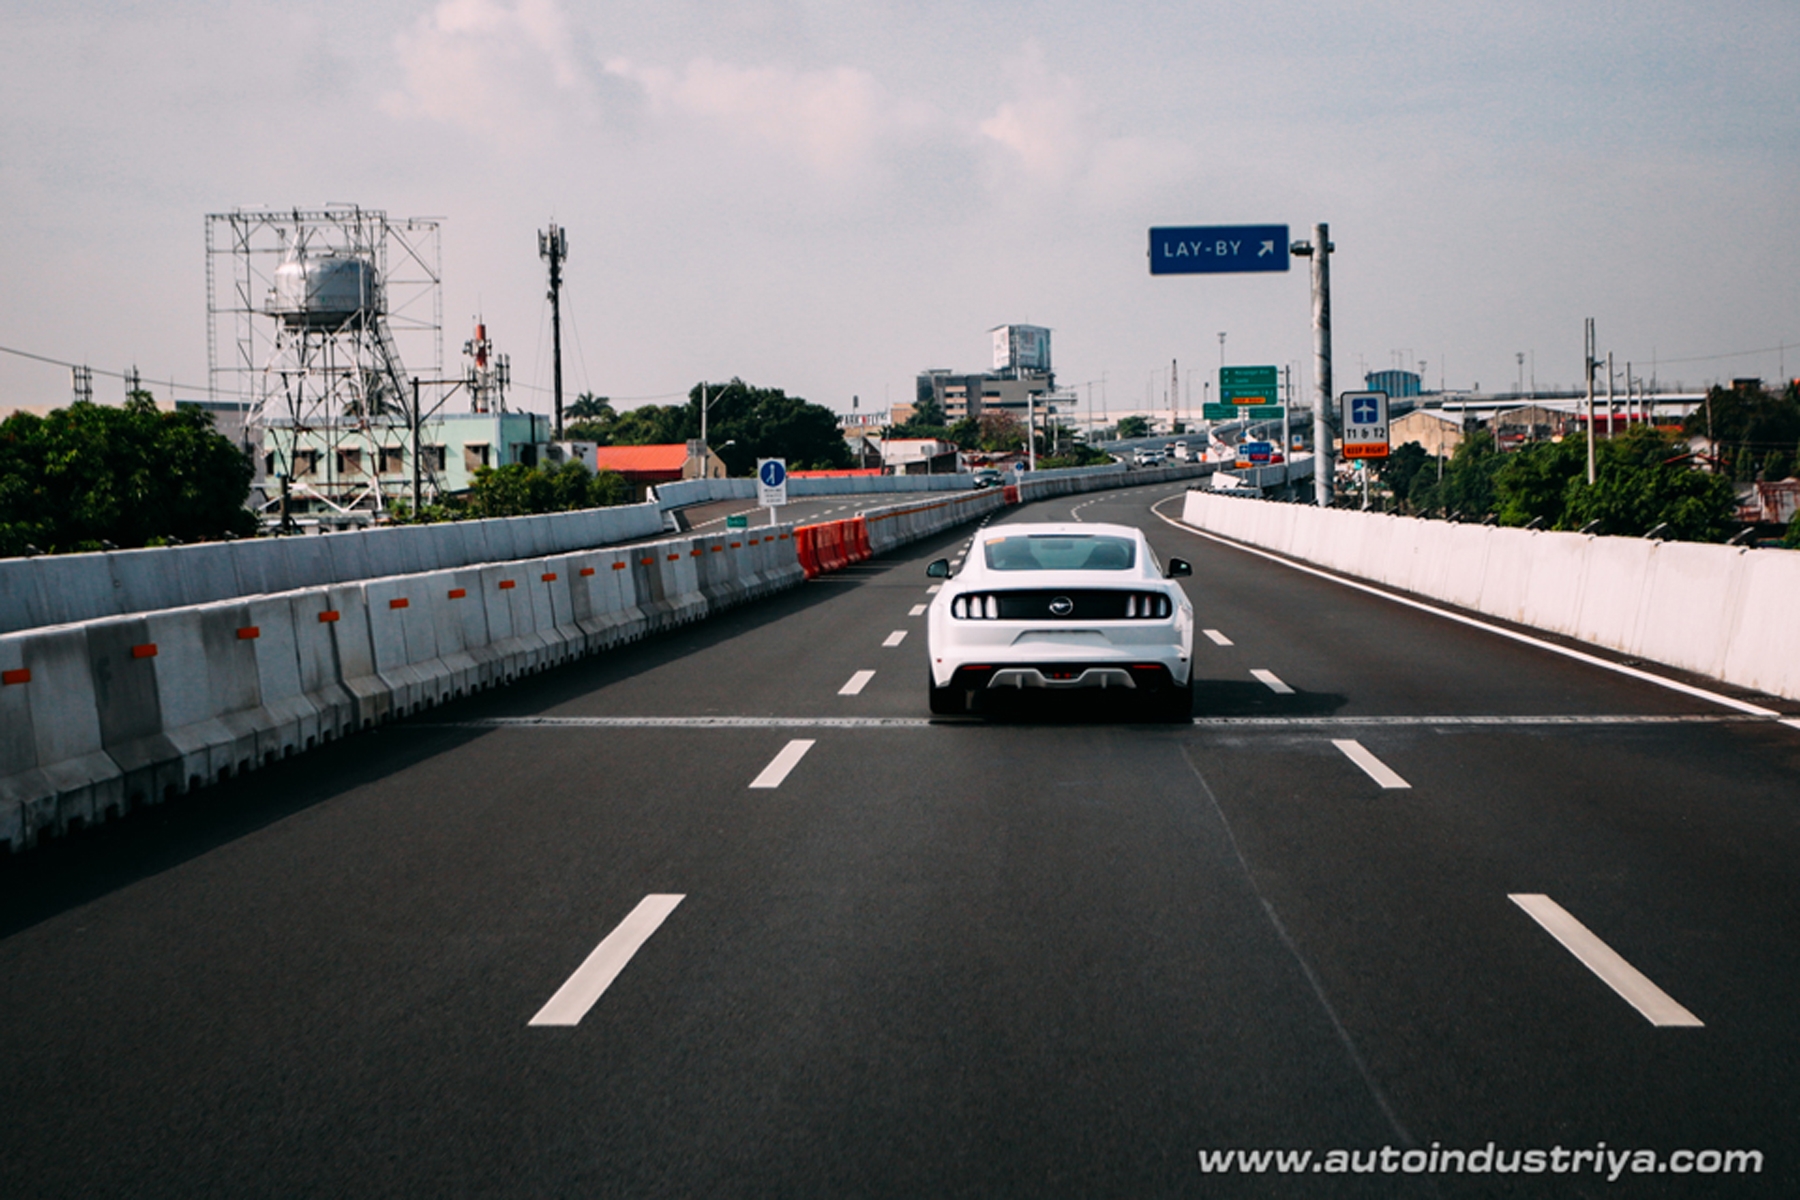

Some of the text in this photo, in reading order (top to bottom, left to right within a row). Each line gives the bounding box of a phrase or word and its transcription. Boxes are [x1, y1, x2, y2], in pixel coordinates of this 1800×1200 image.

[1163, 239, 1241, 258] LAY-BY
[1346, 427, 1385, 439] T1 & T2
[1346, 445, 1385, 455] KEEP RIGHT
